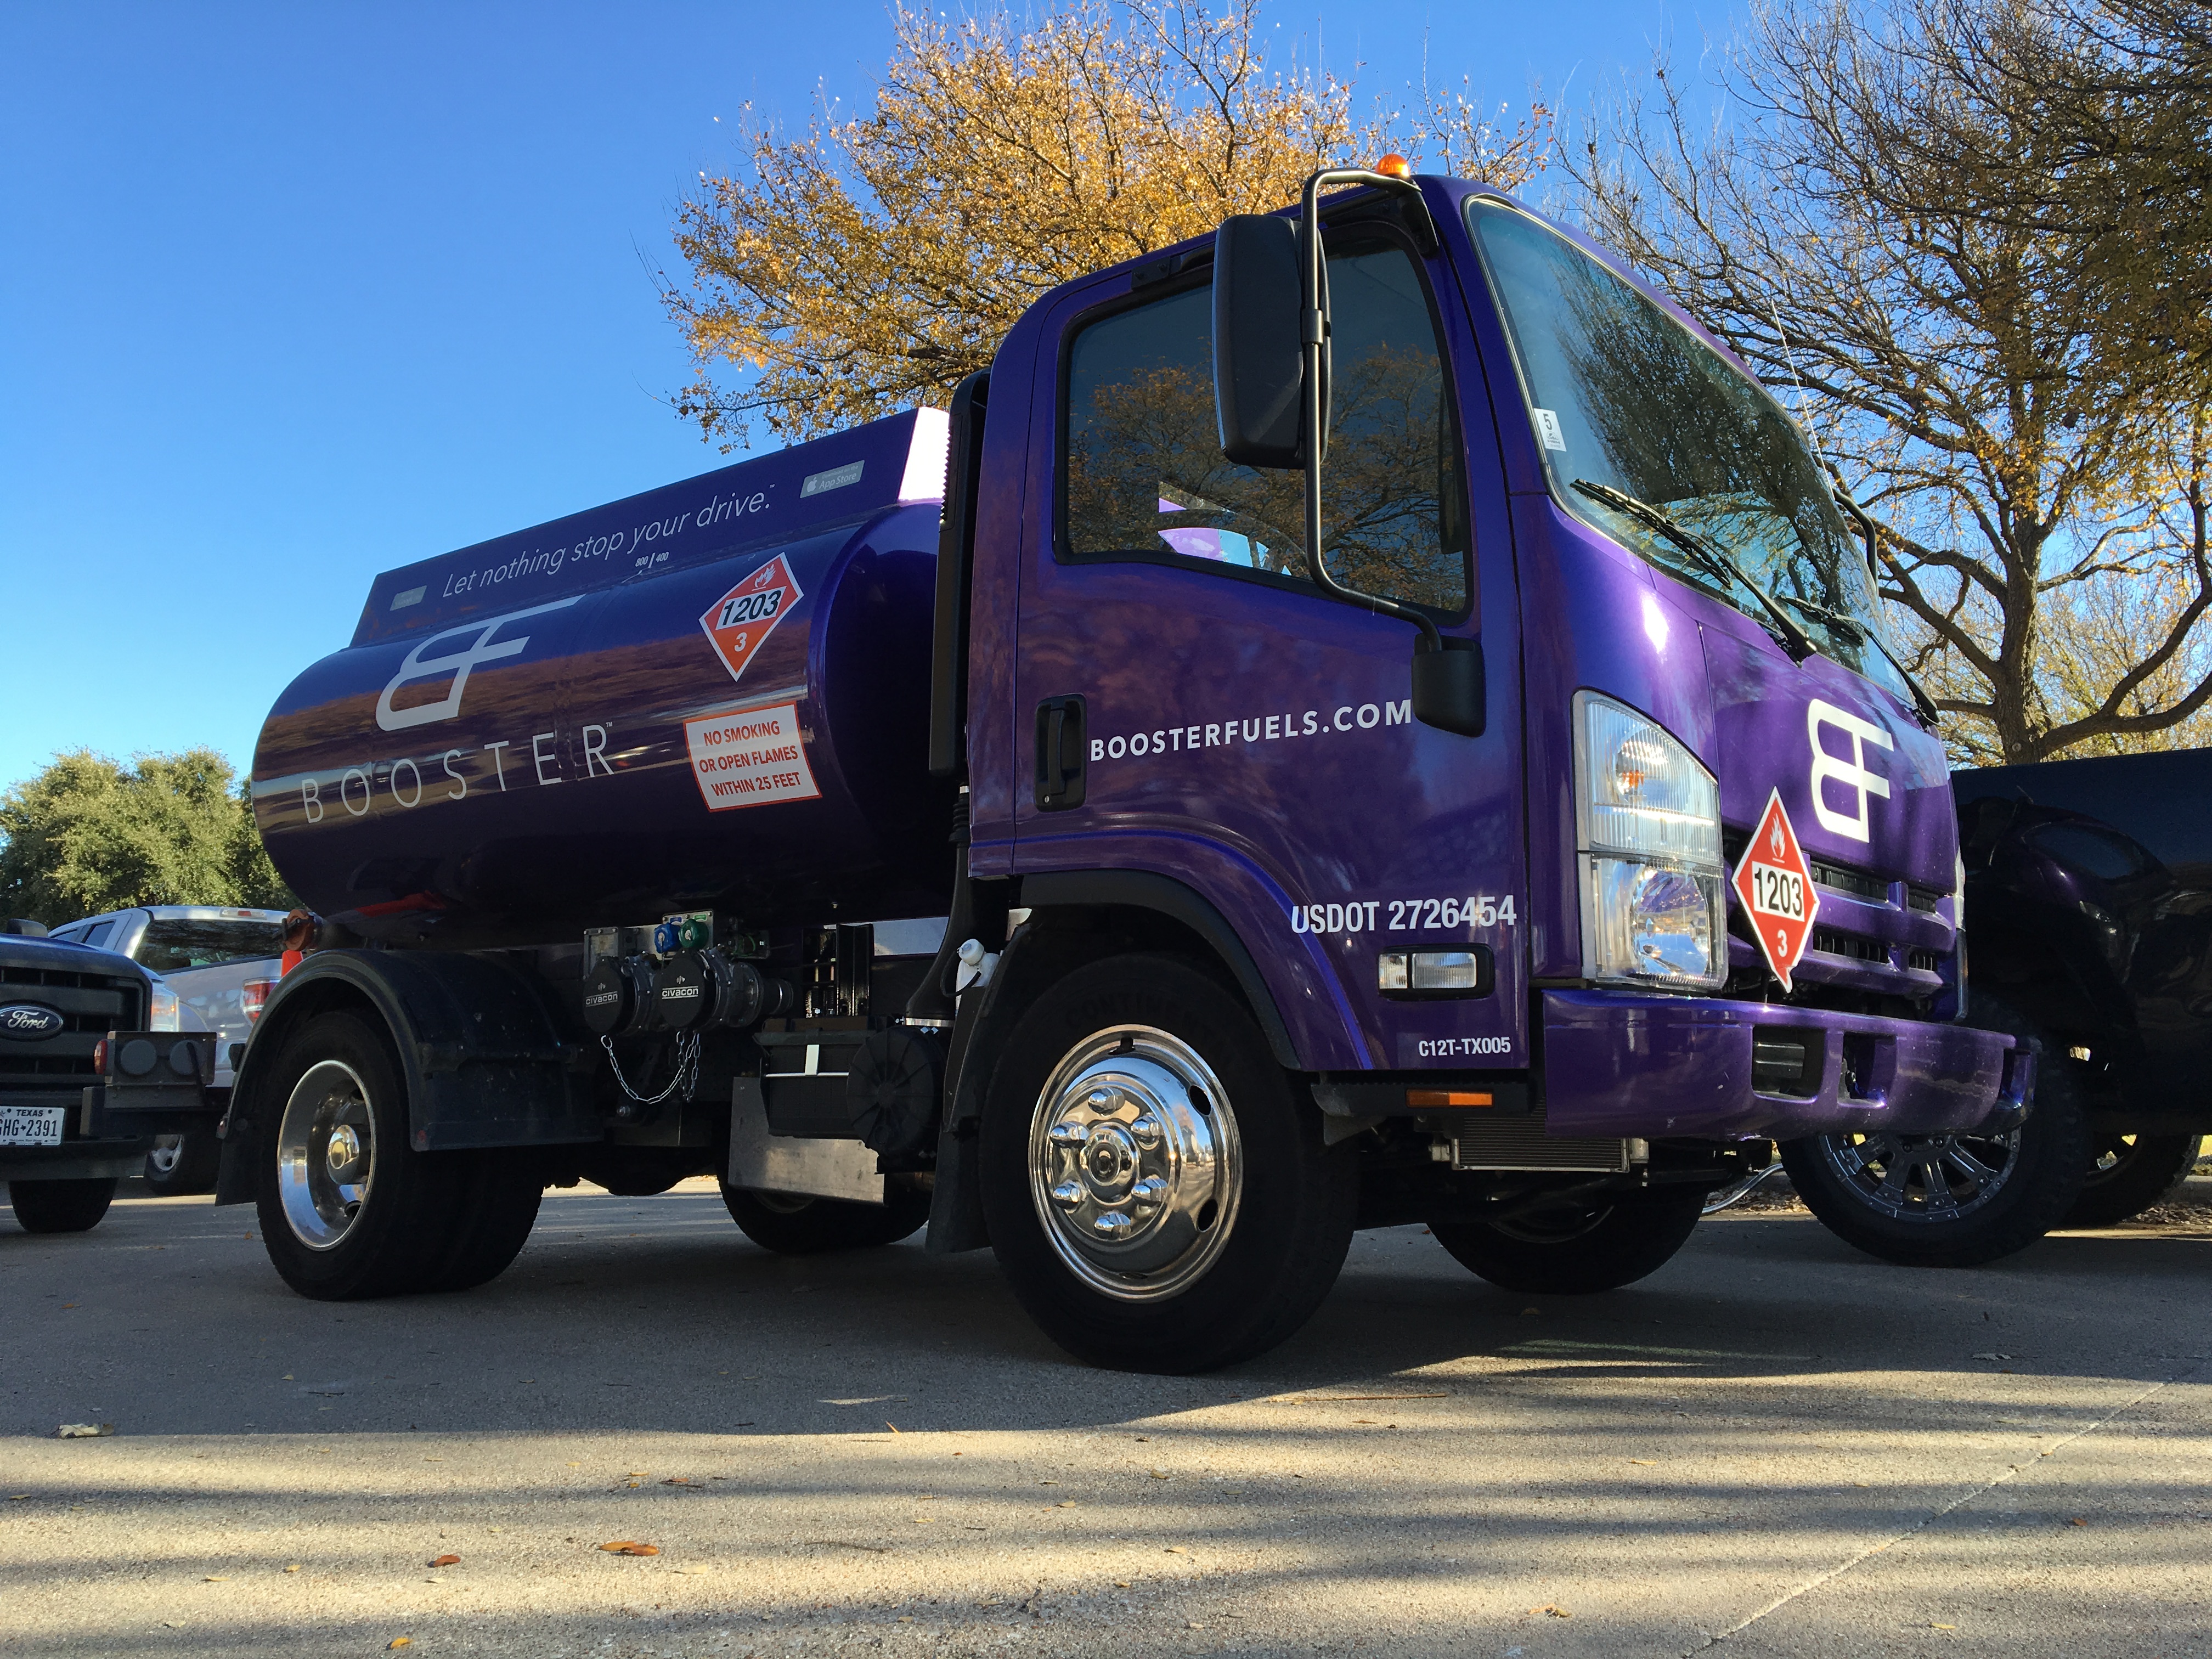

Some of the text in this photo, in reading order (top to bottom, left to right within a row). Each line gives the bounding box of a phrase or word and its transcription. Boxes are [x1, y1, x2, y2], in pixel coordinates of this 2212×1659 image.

[1543, 413, 1552, 431] 5
[819, 473, 857, 490] App Store
[442, 569, 477, 598] Let
[479, 548, 567, 588] nothing
[571, 531, 624, 561] stop
[627, 512, 691, 555] your
[696, 492, 770, 527] drive.
[635, 551, 669, 567] 800 400
[723, 590, 782, 626] 1203
[734, 632, 747, 652] 3
[703, 720, 780, 746] NO SMOKING
[1091, 699, 1412, 761] BOOSTERFUELS.COM
[699, 745, 798, 773] OR OPEN FLAMES
[301, 724, 614, 823] BOOSTER
[710, 771, 801, 796] WITHIN 25 FEET
[1754, 867, 1803, 917] 1203
[1291, 895, 1517, 934] USDOT 2726454
[1778, 929, 1788, 957] 3
[585, 993, 618, 1005] civacon
[662, 988, 698, 997] civacon
[8, 1010, 49, 1029] Ford
[1419, 1037, 1511, 1057] C12T-TX005
